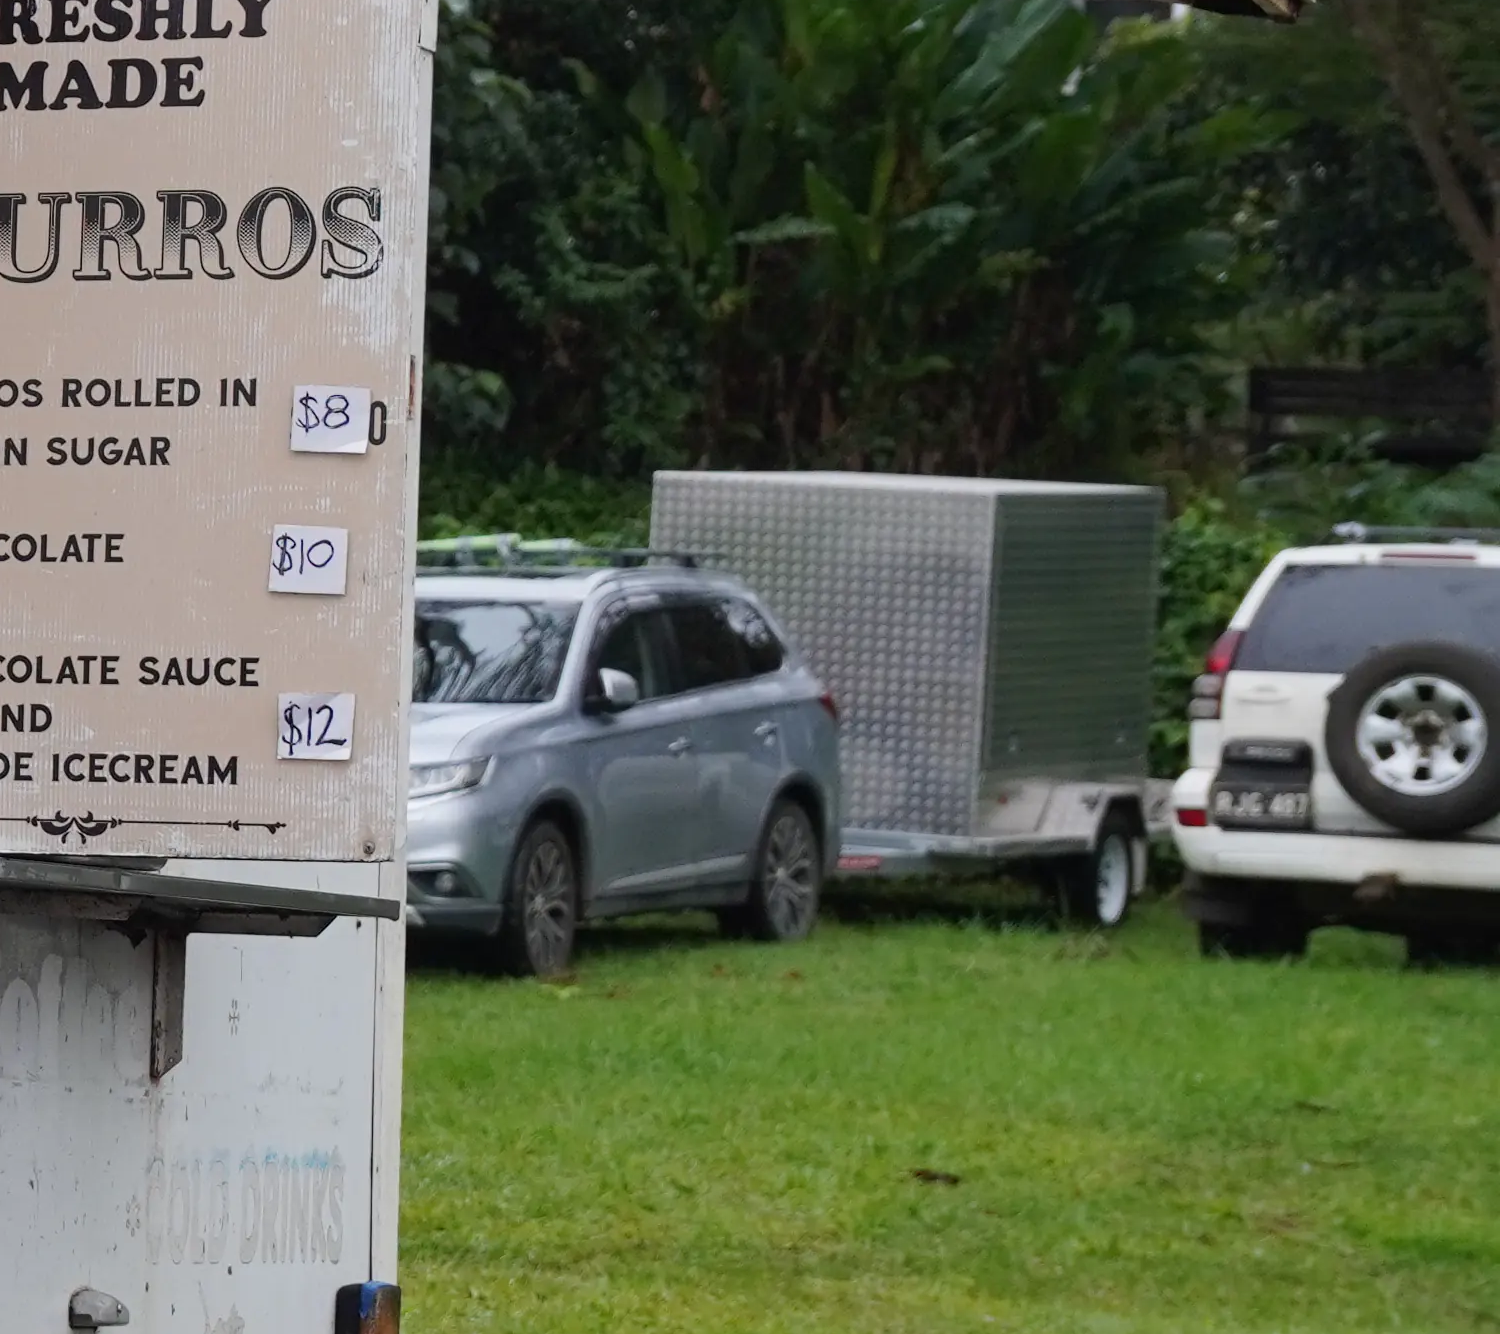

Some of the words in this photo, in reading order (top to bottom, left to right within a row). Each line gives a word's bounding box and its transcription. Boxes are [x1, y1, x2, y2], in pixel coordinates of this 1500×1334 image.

[61, 378, 199, 408] ROLLED
[219, 376, 258, 408] IN
[296, 391, 349, 433] $8
[47, 436, 171, 467] SUGAR
[271, 533, 334, 577] $10
[139, 657, 260, 688] SAUCE
[283, 704, 347, 747] $12
[52, 754, 239, 786] ICECREAM
